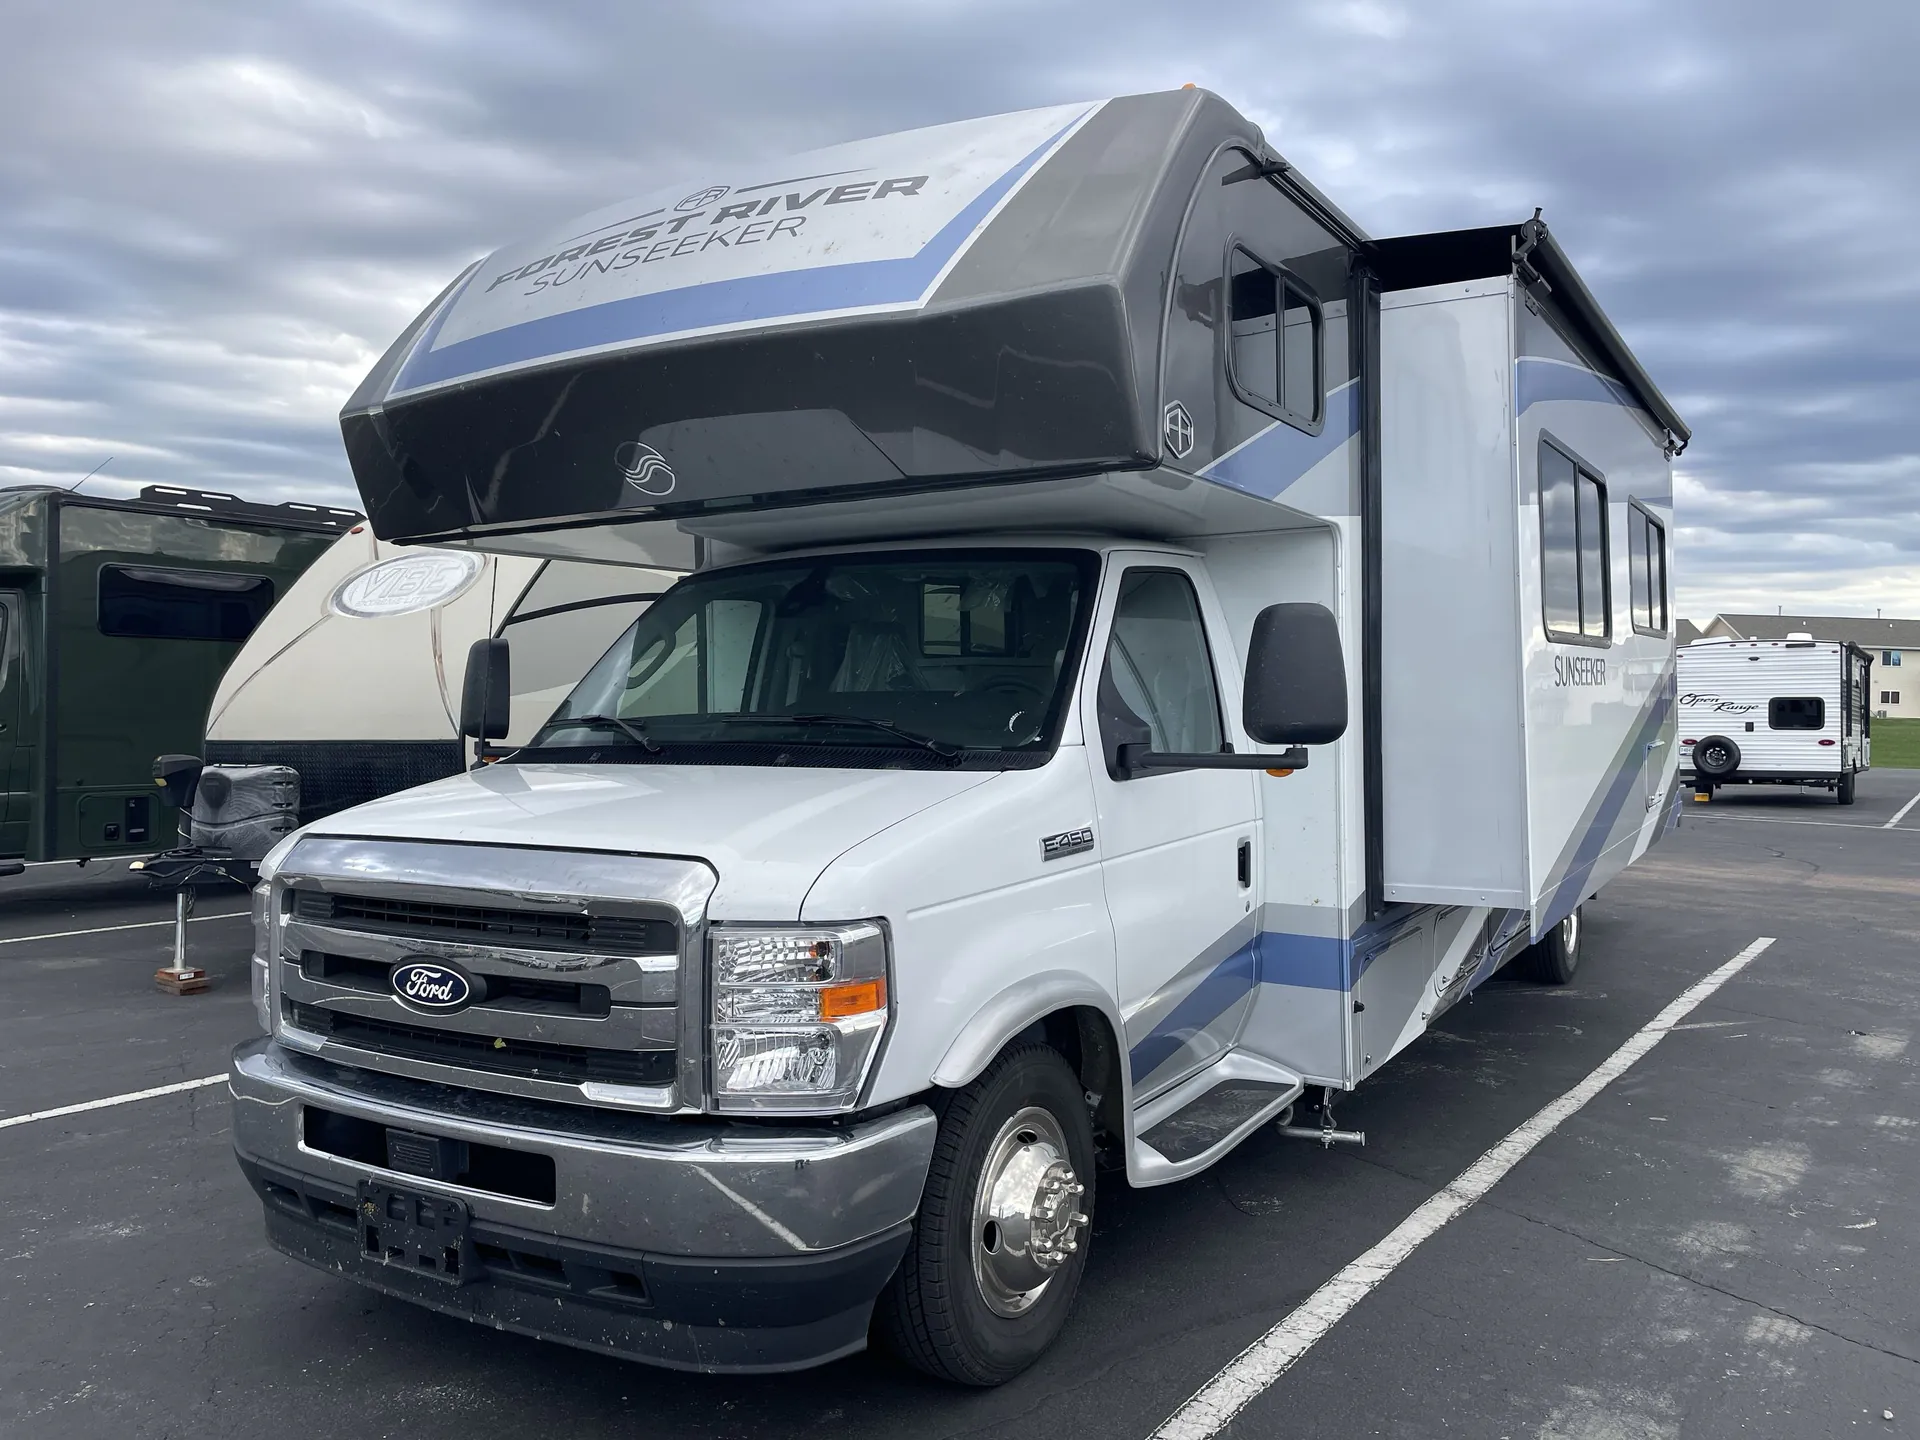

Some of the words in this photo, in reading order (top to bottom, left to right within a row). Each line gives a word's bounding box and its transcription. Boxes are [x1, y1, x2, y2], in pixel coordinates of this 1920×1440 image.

[485, 211, 706, 293] FOREST
[710, 175, 929, 225] RIVER
[524, 216, 807, 296] SUNSEEKER
[361, 563, 463, 599] VIBE
[1554, 654, 1607, 687] SUNSEEKER
[1680, 693, 1720, 708] Open
[1710, 701, 1759, 715] Range
[1042, 829, 1094, 853] E-450
[406, 968, 454, 1001] Ford
